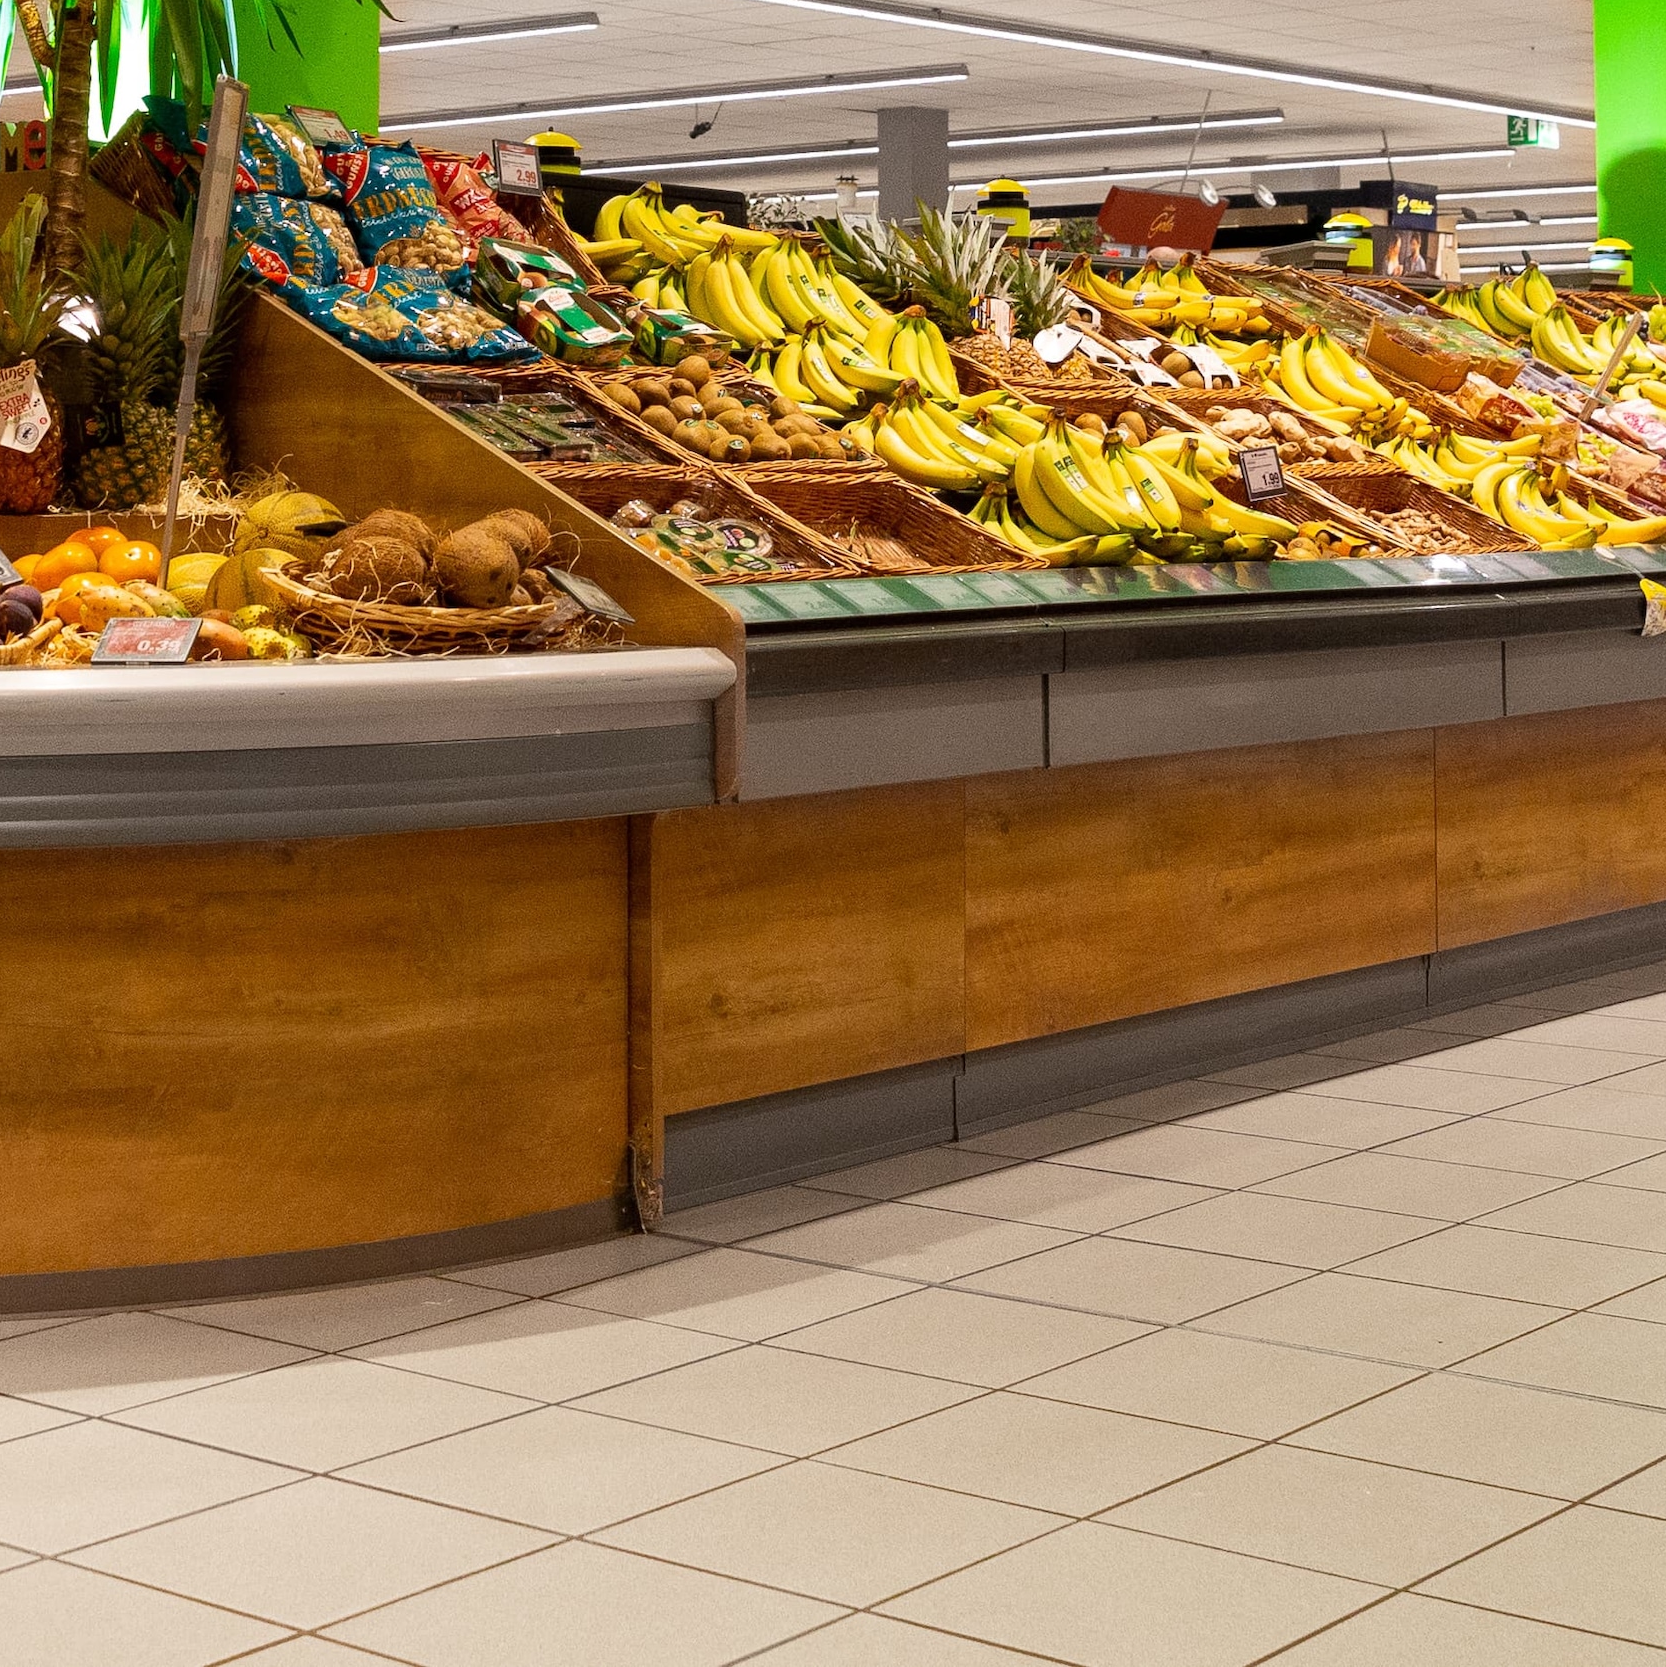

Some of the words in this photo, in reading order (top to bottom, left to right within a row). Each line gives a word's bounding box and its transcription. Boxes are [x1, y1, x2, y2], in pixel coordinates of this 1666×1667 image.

[516, 168, 537, 184] 2.99
[1, 403, 32, 421] SWEET
[1261, 471, 1280, 486] 1.99
[136, 639, 181, 654] 0.39
